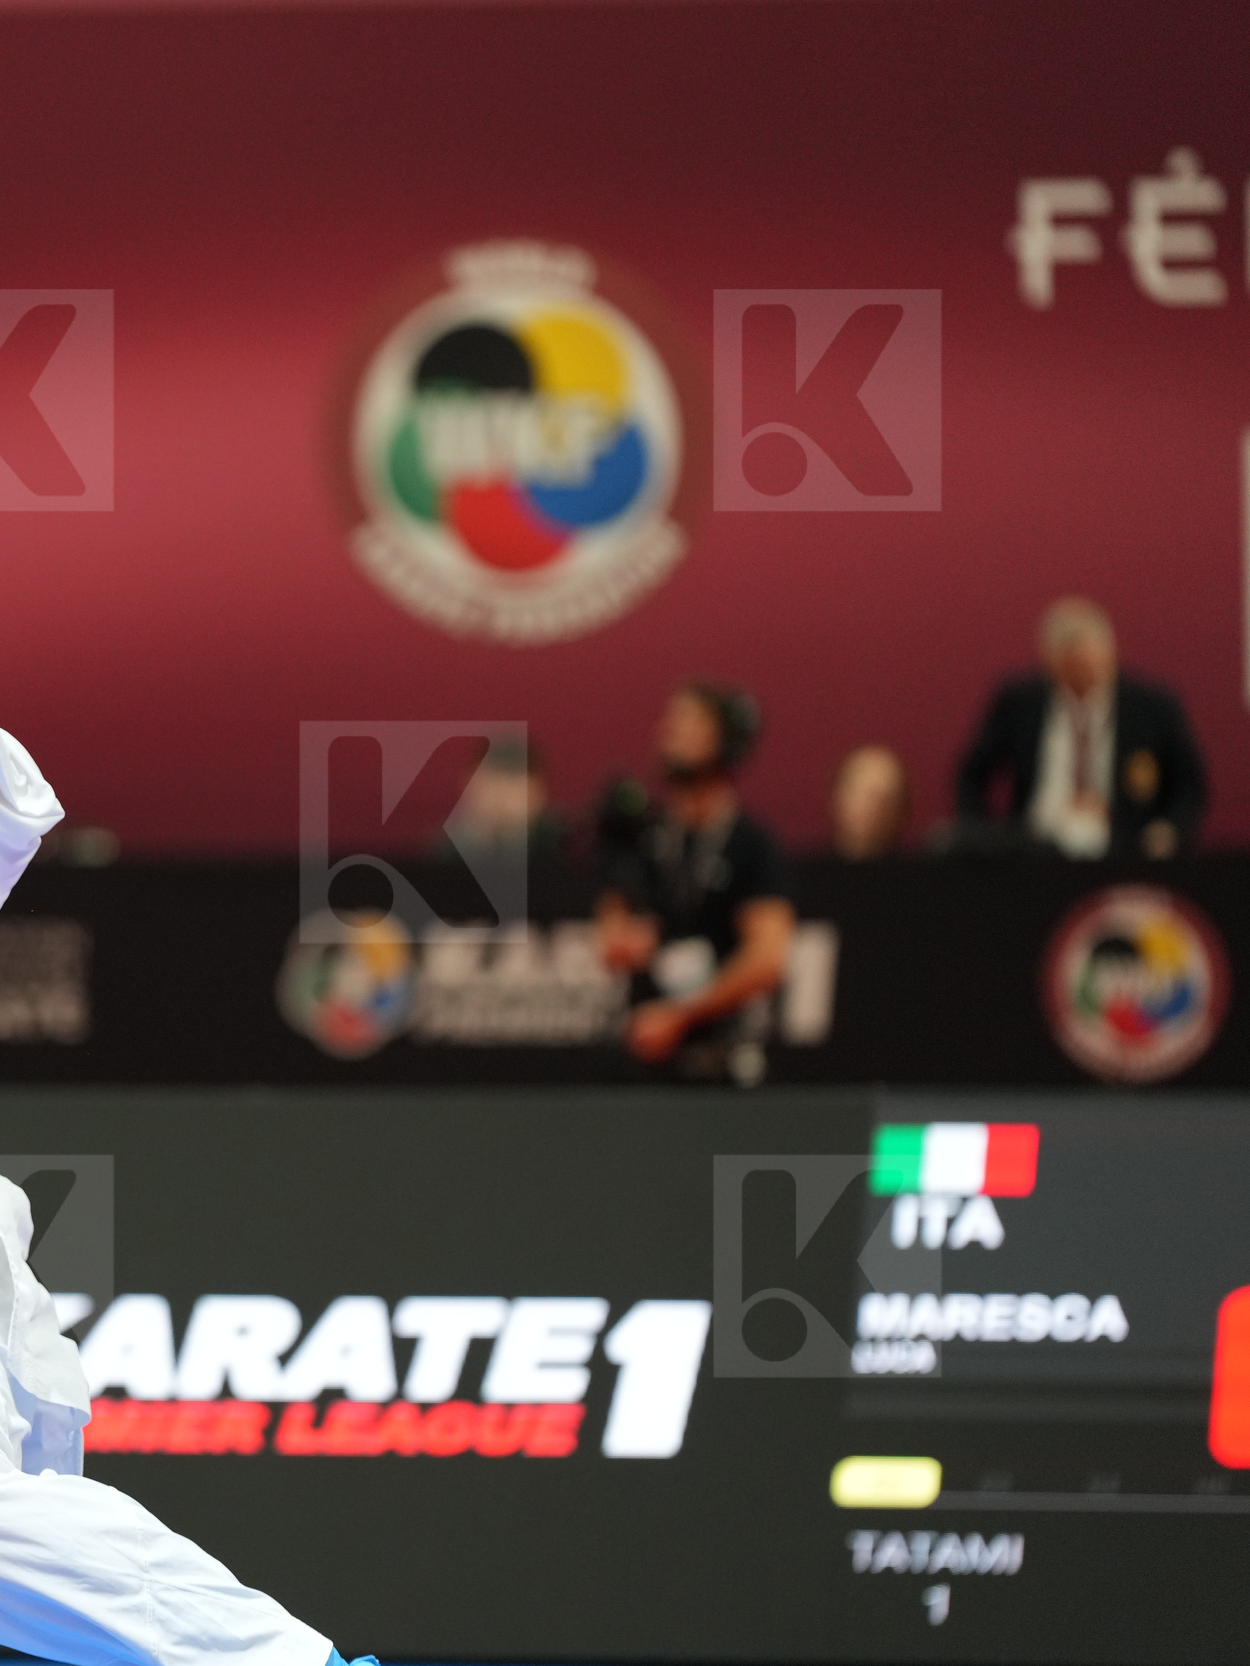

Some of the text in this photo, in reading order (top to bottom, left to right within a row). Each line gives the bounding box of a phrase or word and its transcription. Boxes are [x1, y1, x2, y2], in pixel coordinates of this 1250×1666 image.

[1010, 148, 1250, 308] FÉ
[891, 1194, 1006, 1250] ITA
[856, 1292, 1130, 1343] MARESCA
[274, 1402, 586, 1458] LEAGUE
[847, 1529, 1026, 1576] TATAMI
[922, 1582, 951, 1627] 1
